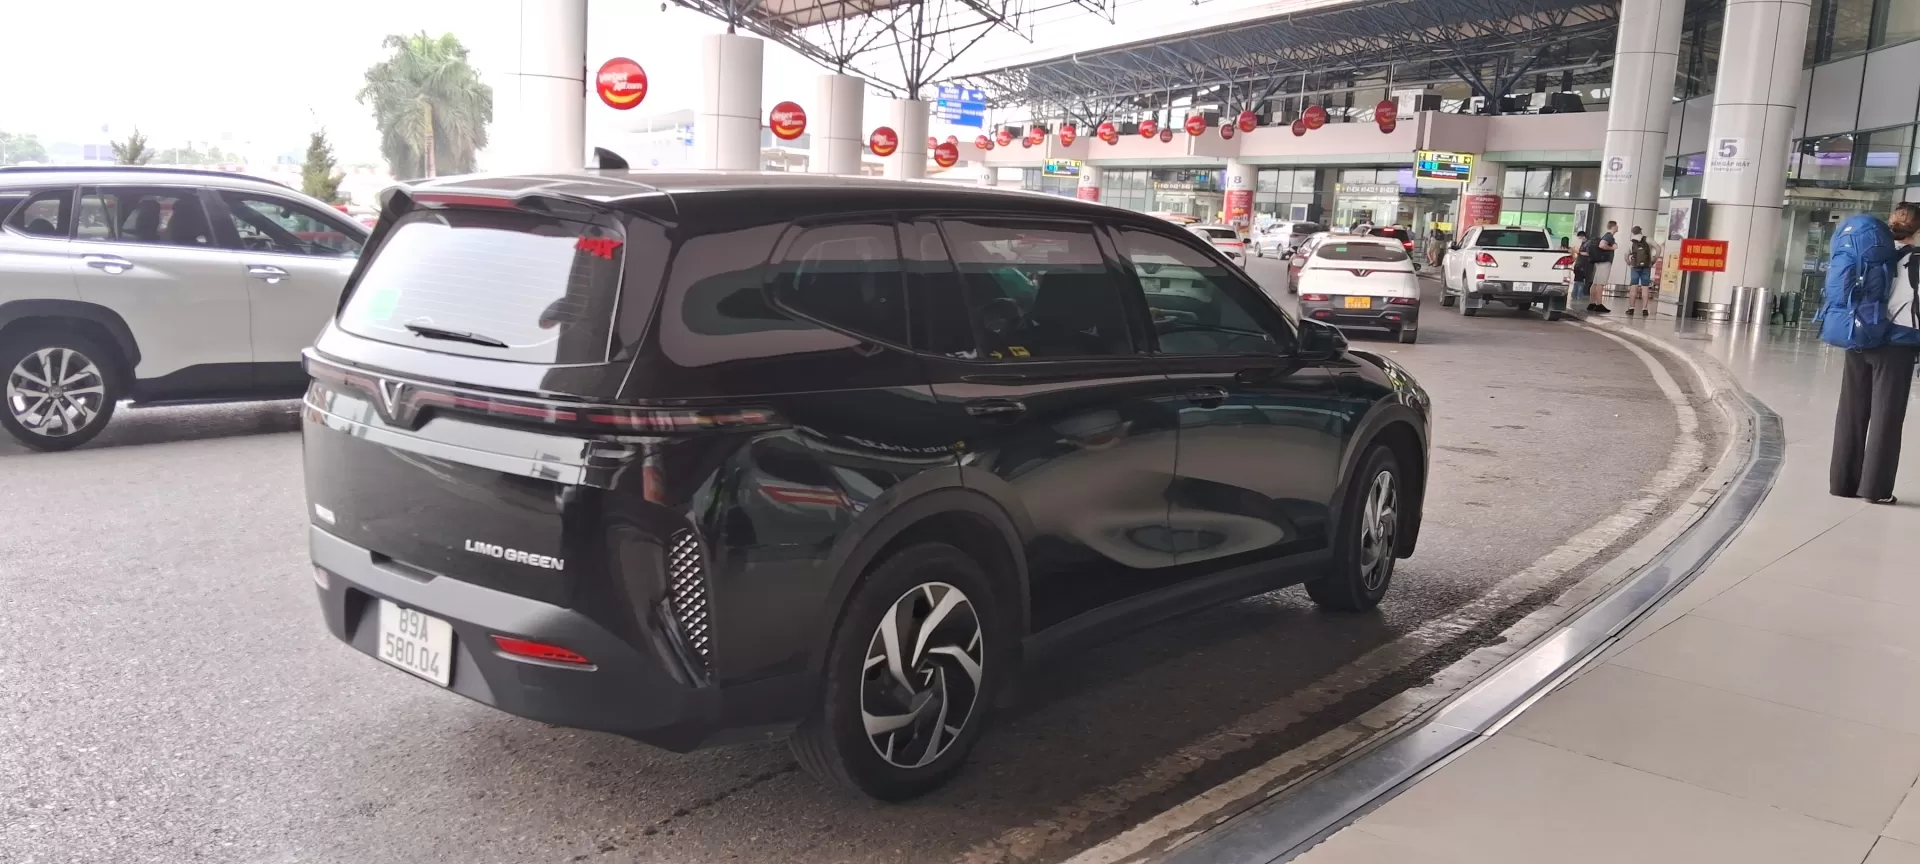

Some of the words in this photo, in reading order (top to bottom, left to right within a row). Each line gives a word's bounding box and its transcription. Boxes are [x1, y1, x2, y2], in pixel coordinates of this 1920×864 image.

[1718, 139, 1738, 158] 5
[1608, 157, 1623, 171] 6
[1234, 176, 1242, 184] 8
[1477, 176, 1487, 186] 7
[464, 539, 504, 558] LIMO
[504, 548, 565, 571] GREEN
[399, 609, 428, 643] 89A
[386, 632, 440, 677] 580.04
